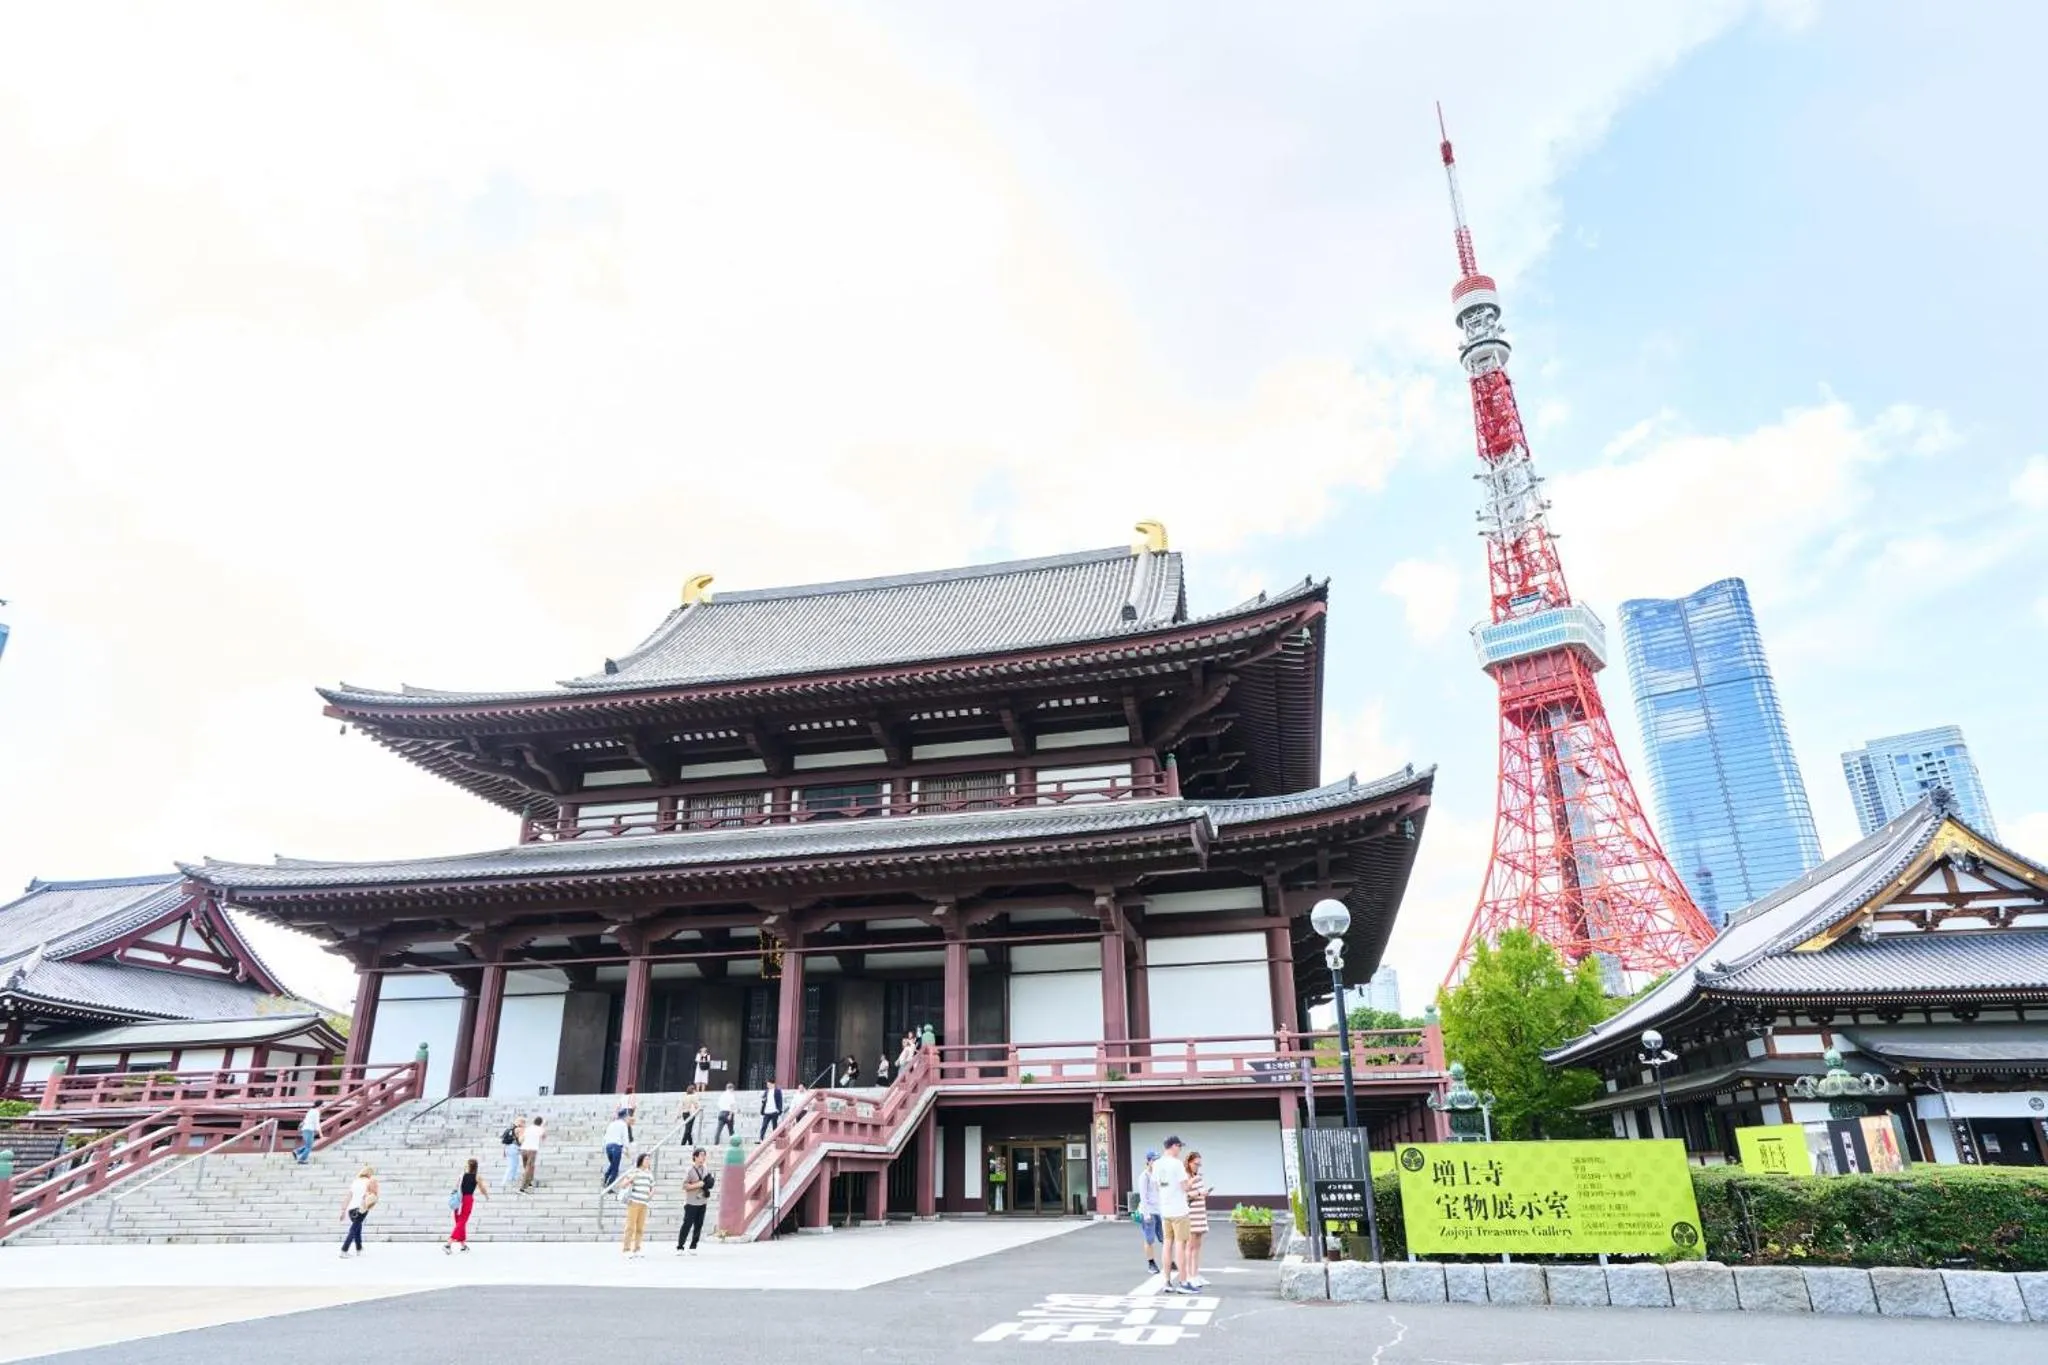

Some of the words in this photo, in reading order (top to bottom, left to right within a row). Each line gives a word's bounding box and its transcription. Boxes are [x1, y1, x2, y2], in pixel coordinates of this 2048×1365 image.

[1432, 1159, 1503, 1188] 増上寺
[1435, 1190, 1572, 1221] 宝物展示室
[1440, 1226, 1473, 1240] Zojoji
[1476, 1226, 1529, 1238] Treasures
[1532, 1225, 1573, 1240] Gallery
